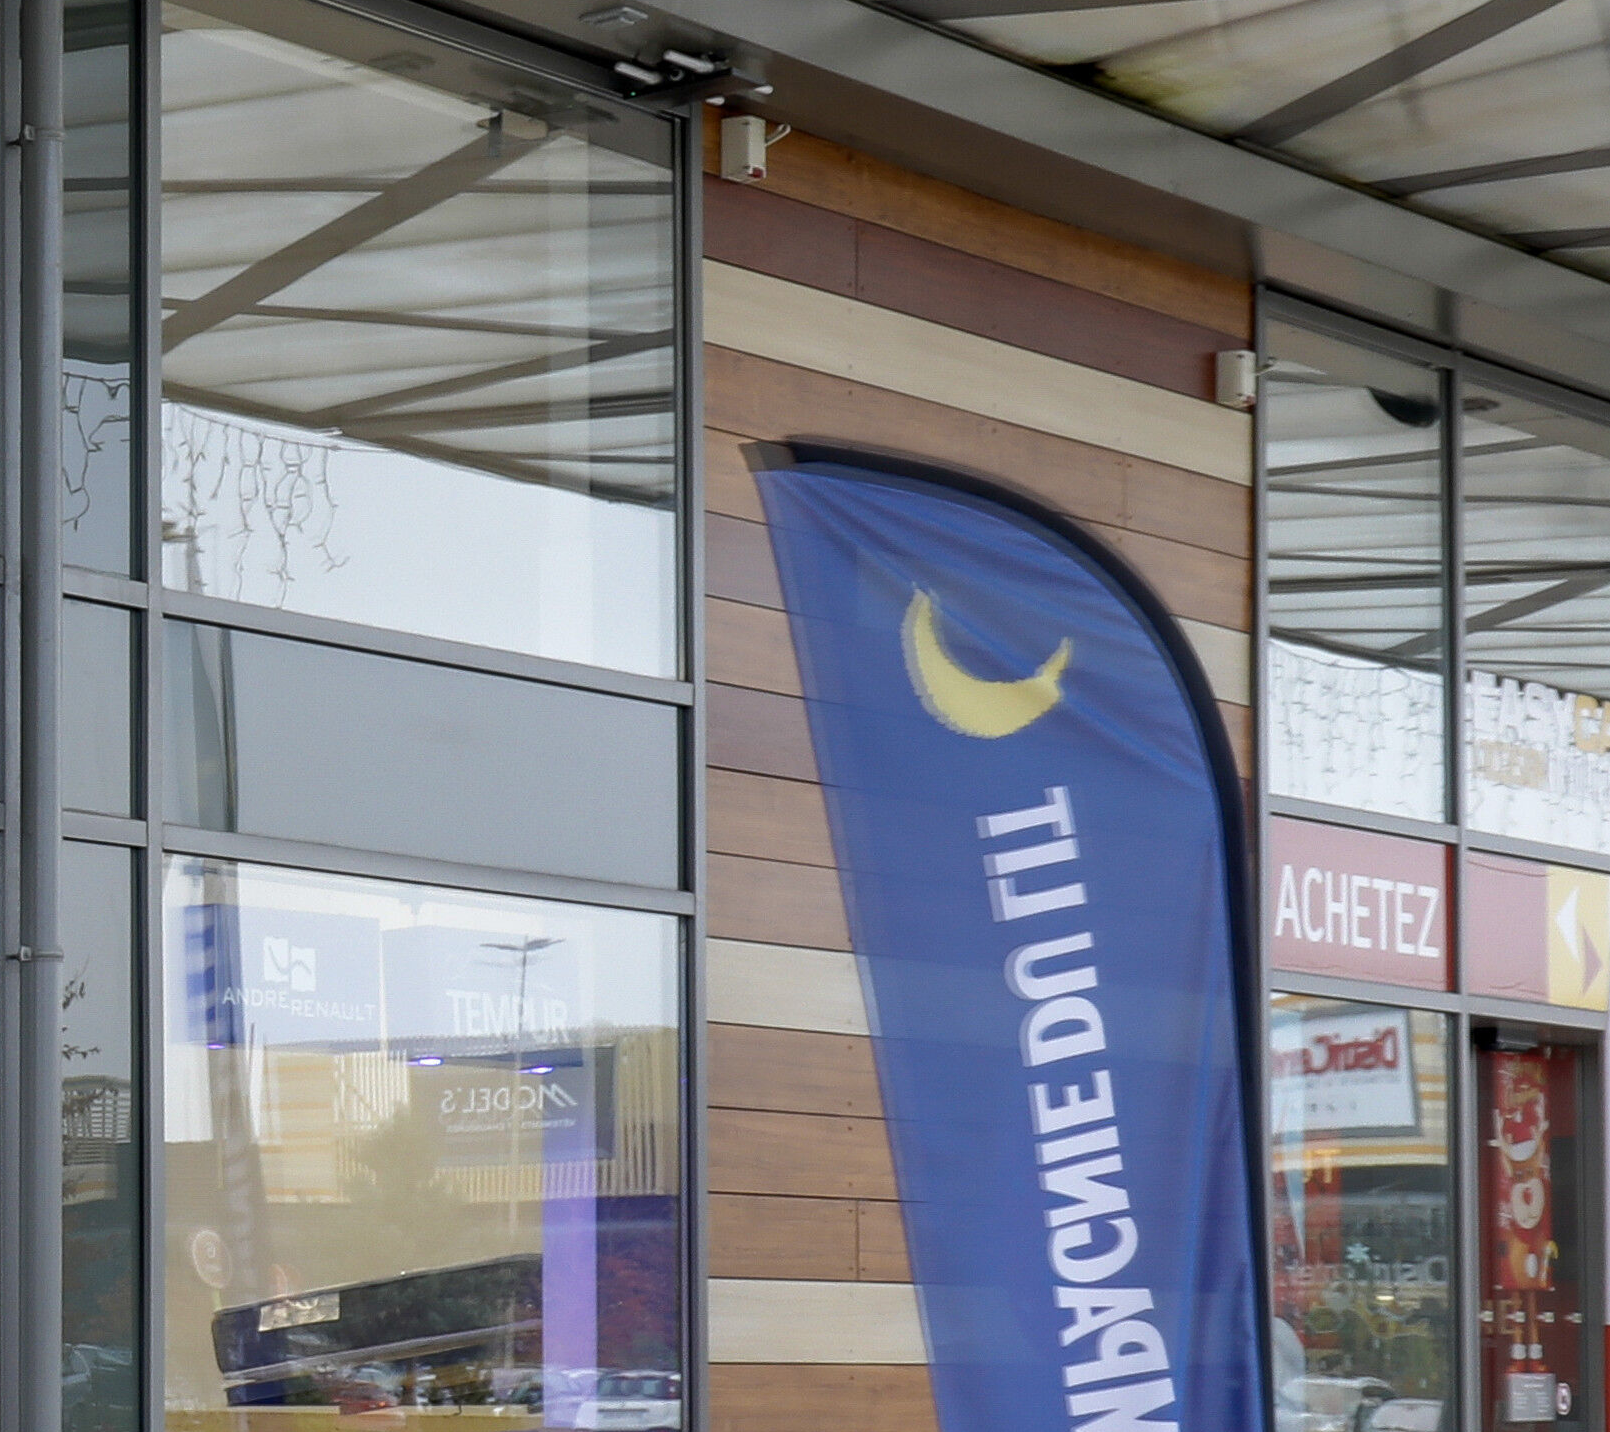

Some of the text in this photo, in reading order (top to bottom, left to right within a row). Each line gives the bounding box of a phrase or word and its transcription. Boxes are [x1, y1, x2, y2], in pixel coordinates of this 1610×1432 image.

[1275, 865, 1440, 958] ACHETEZ
[290, 999, 378, 1021] RENAULT
[445, 989, 569, 1043] TEMPUR
